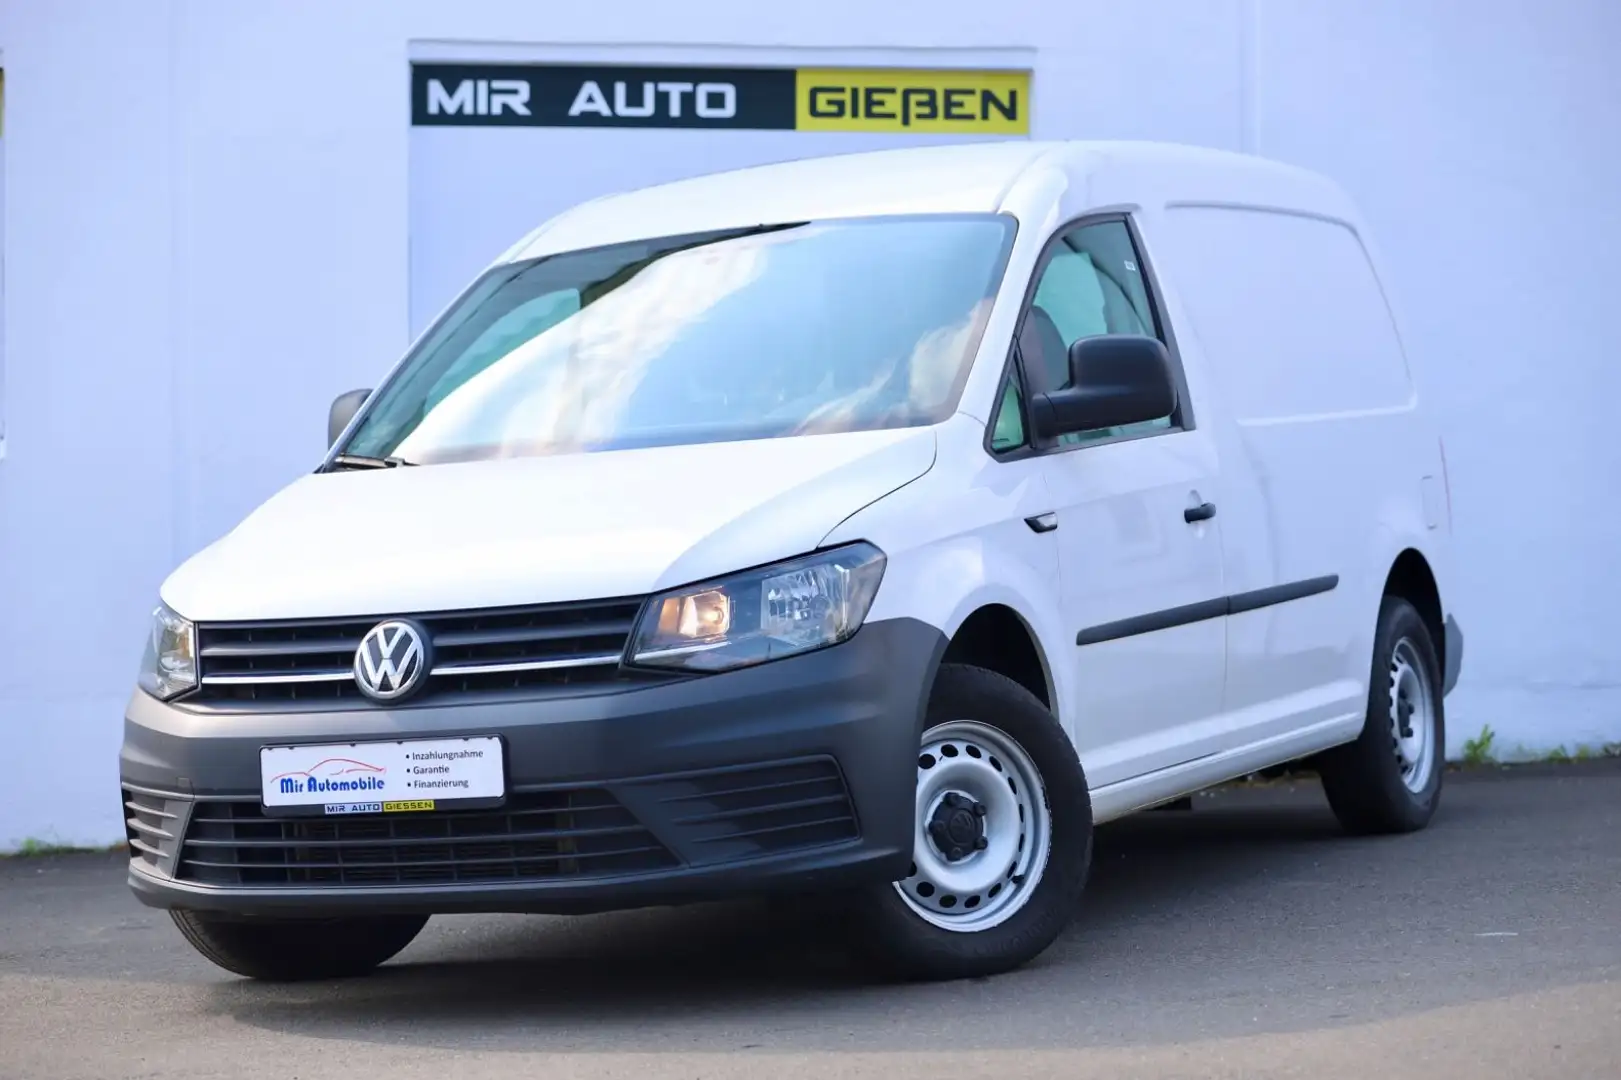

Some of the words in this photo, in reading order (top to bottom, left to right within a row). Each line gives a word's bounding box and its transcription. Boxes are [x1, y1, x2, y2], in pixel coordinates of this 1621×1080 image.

[426, 79, 531, 116] MIR
[567, 81, 737, 118] AUTO
[808, 86, 1019, 127] GIEßEN
[357, 624, 420, 696] VW
[412, 749, 483, 761] Inzahlungnahme
[413, 765, 450, 775] Garantie
[280, 777, 304, 794] Mir
[307, 776, 385, 793] Automobile
[414, 778, 469, 790] Finanzierung
[326, 804, 346, 813] MIR
[351, 803, 380, 812] AUTO
[385, 801, 433, 811] GIESSEN
